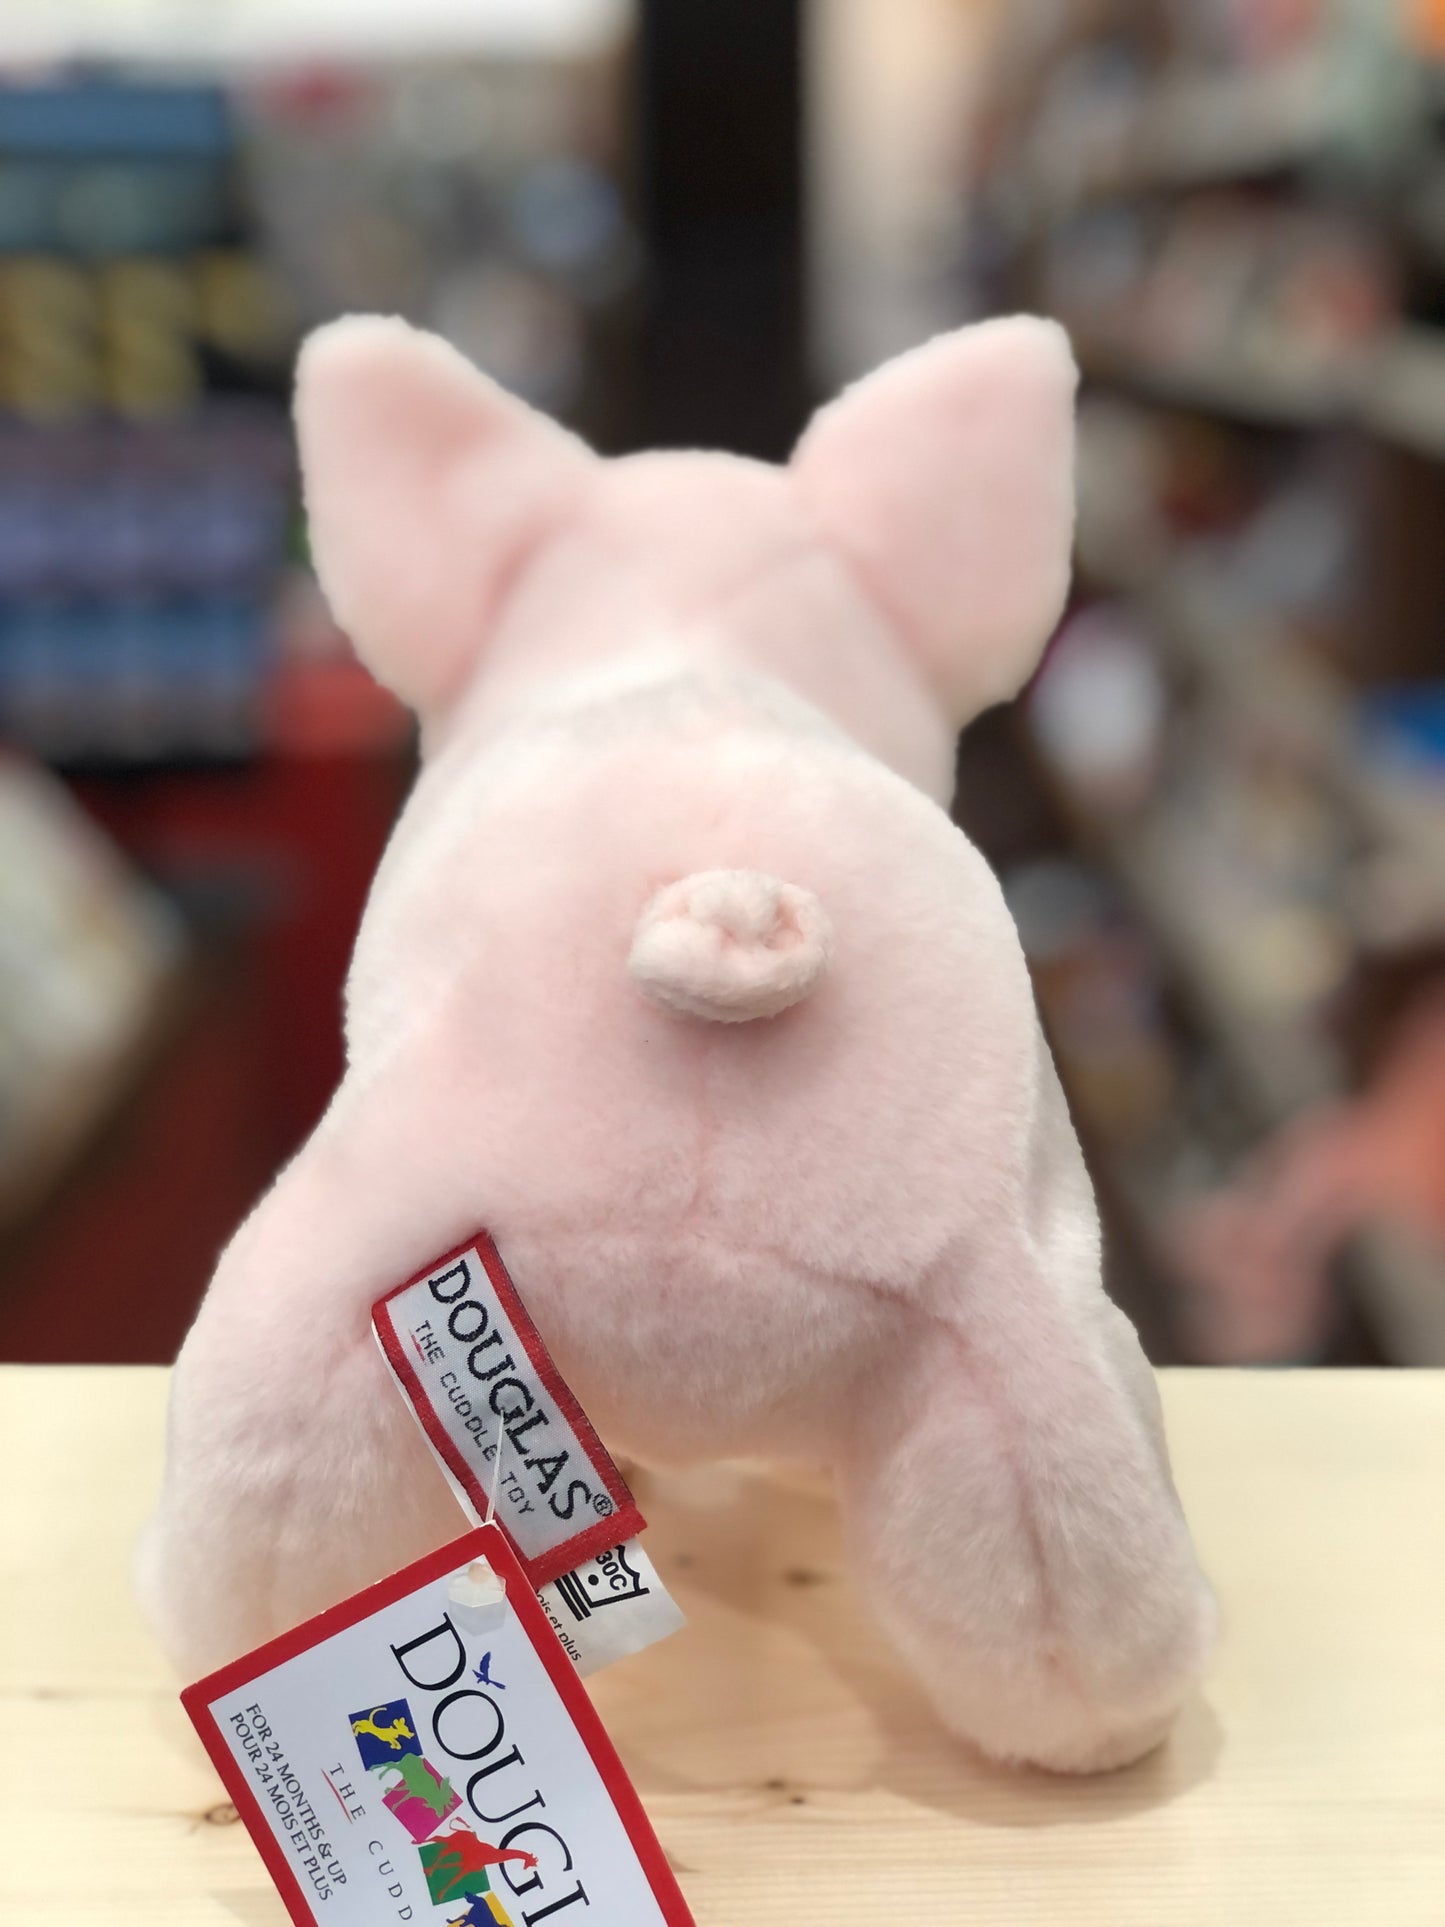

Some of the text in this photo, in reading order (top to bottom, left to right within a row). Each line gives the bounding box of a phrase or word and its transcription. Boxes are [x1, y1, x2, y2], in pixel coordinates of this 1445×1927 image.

[415, 1319, 535, 1514] THE CUDDLE TOY
[549, 1616, 563, 1631] et
[558, 1632, 582, 1661] plus
[595, 1550, 628, 1591] 30C
[230, 1712, 334, 1901] POUR 24 MOIS ET PLUS
[246, 1703, 347, 1885] FOR 24 MONTHS & UP
[329, 1762, 413, 1921] THE CUDD
